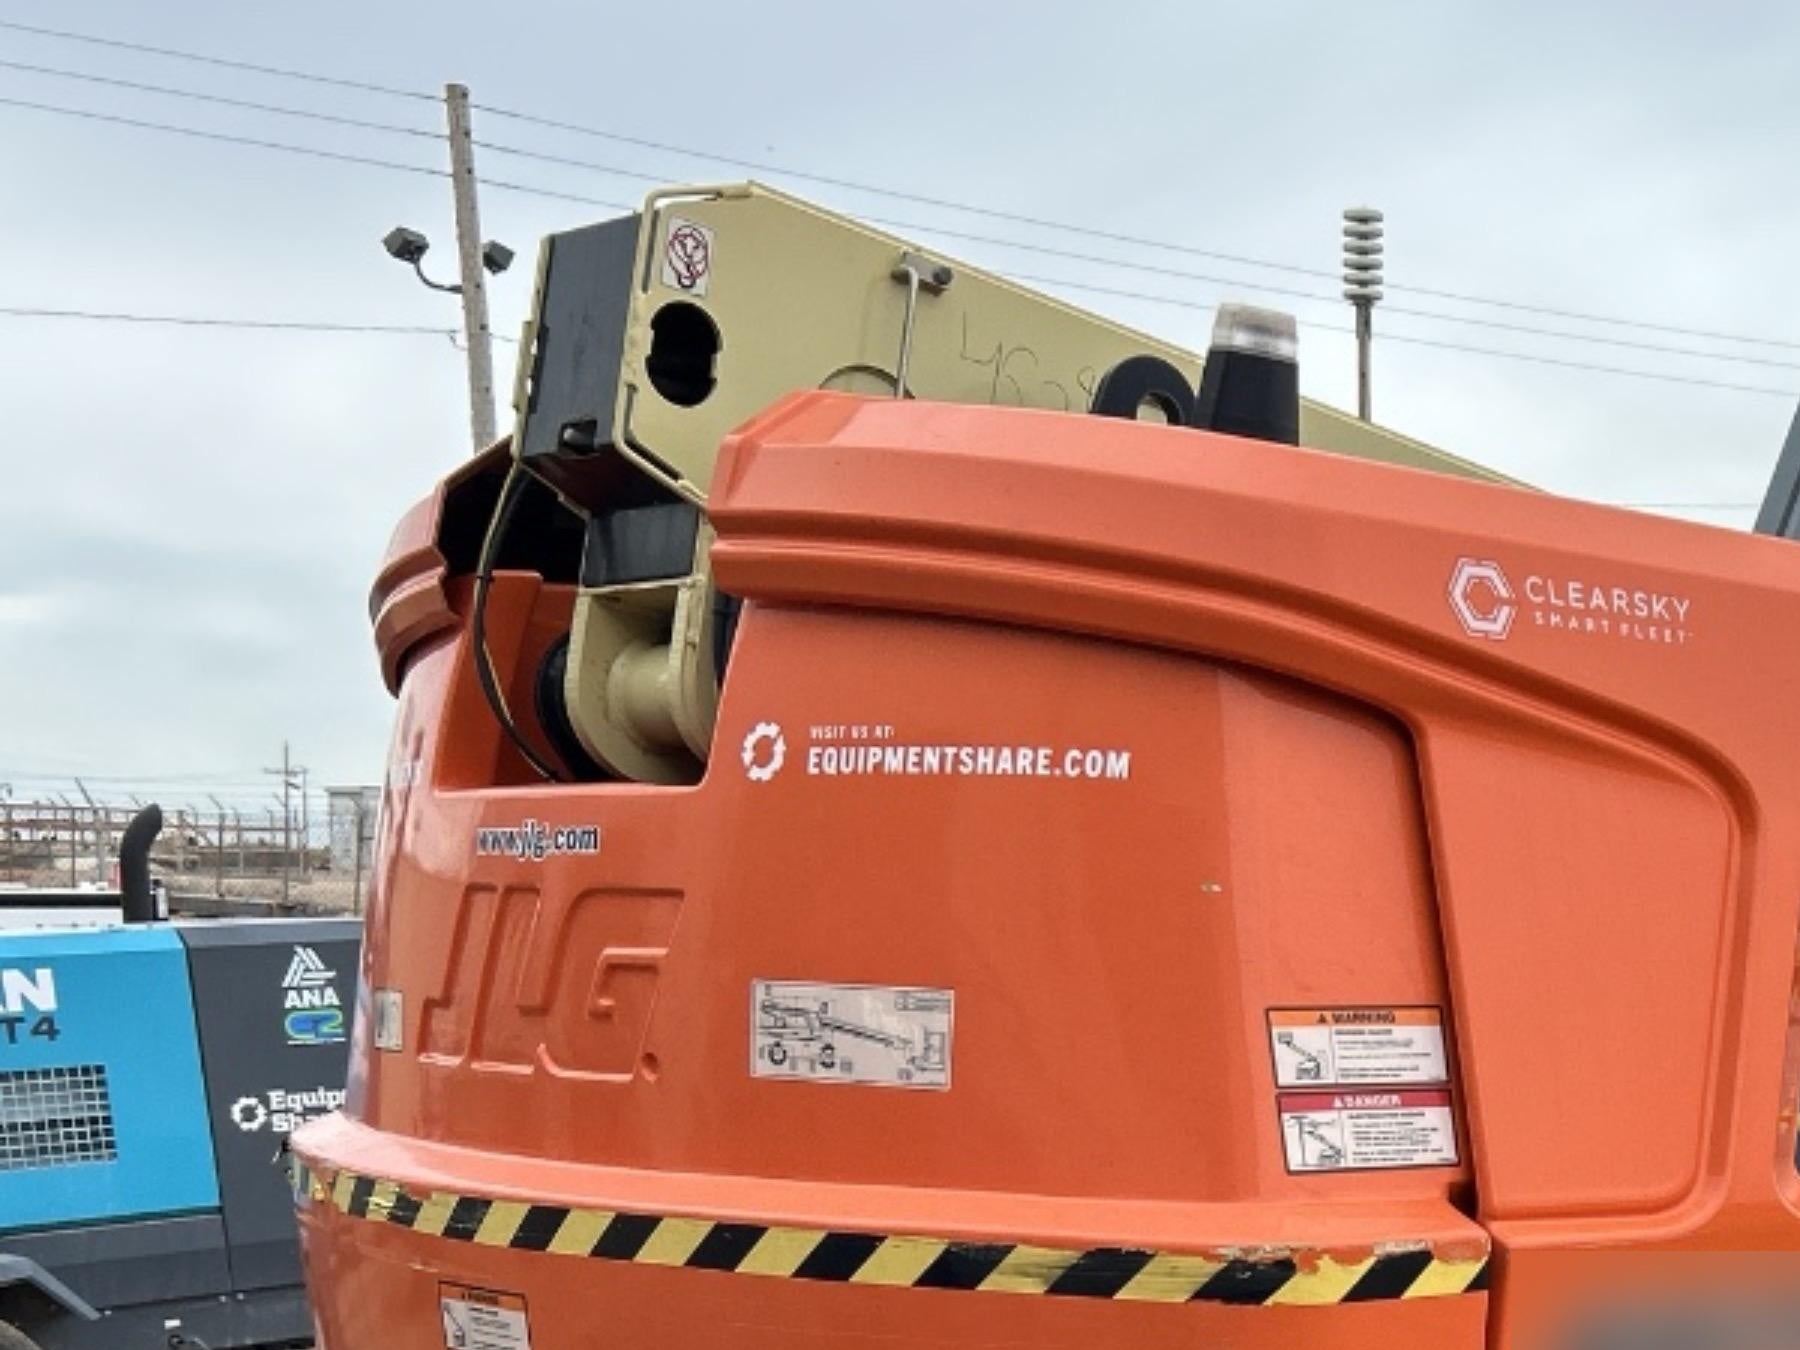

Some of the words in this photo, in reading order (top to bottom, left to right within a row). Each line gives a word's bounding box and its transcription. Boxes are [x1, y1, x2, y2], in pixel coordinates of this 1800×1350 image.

[1525, 575, 1690, 622] CLEARSKY
[1535, 611, 1610, 634] SMART
[1620, 623, 1688, 644] FLEET
[807, 745, 1132, 780] EQUIPMENTSHARE.COM
[477, 819, 601, 861] www.jlg.com
[0, 966, 58, 1012] N
[284, 986, 341, 1009] ANA
[416, 881, 686, 1084] JLG
[266, 1086, 347, 1113] Equip
